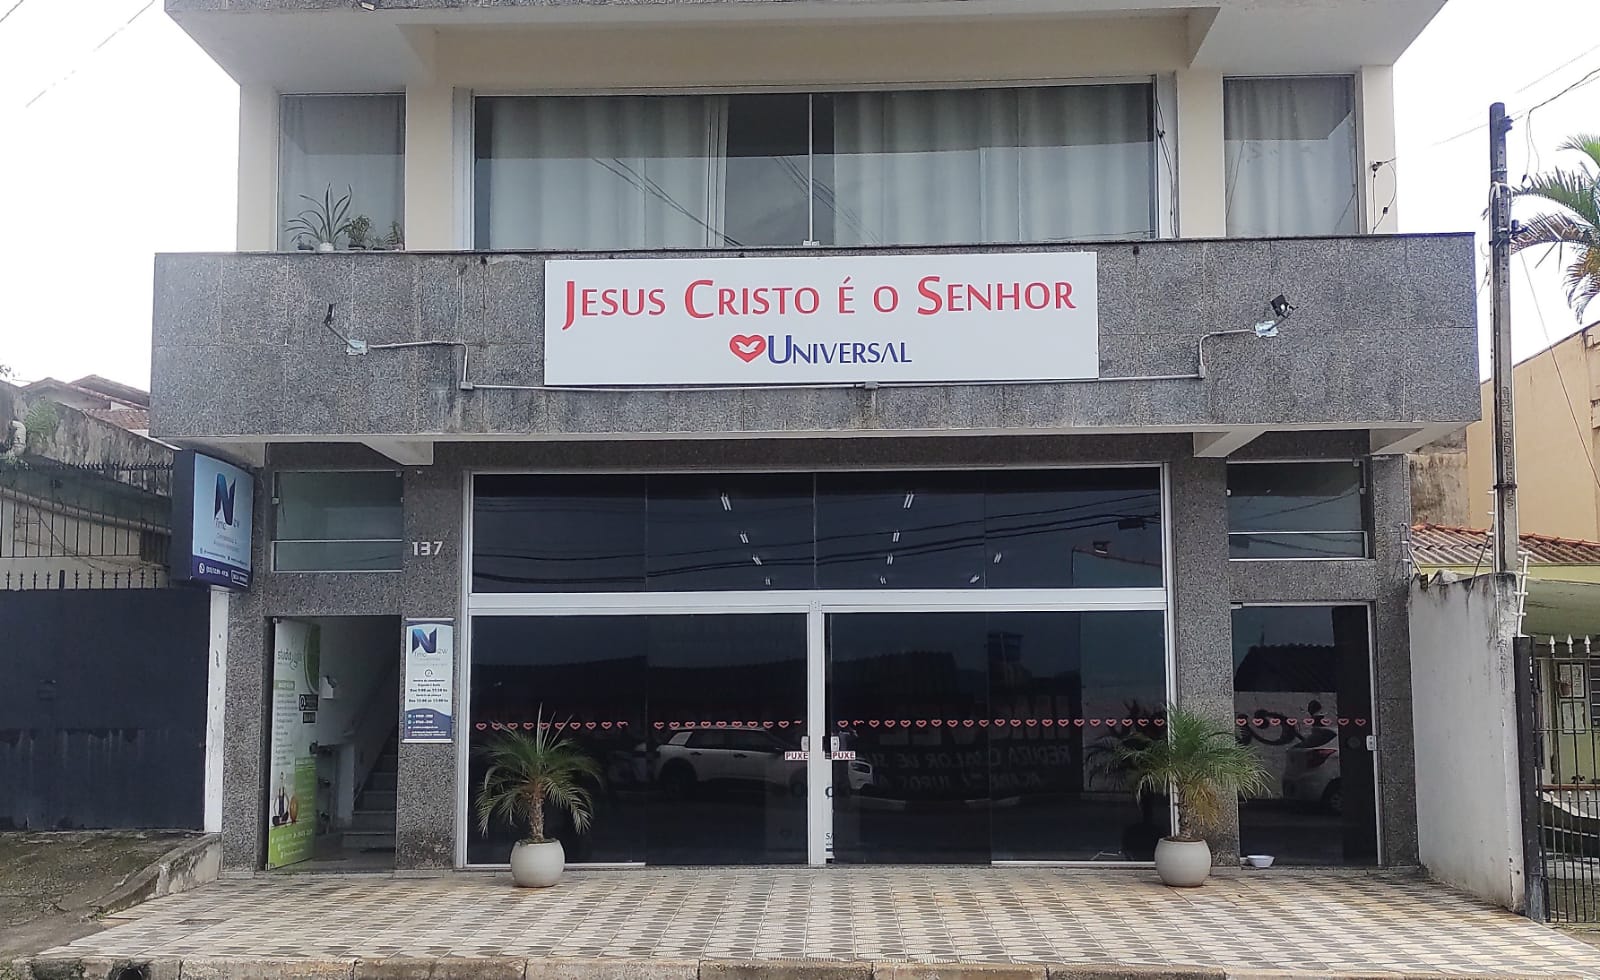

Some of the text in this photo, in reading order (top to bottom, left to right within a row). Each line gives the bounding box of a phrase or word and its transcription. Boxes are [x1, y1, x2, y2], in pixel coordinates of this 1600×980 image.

[562, 275, 1077, 330] JESUS CRISTO É O SENHOR
[767, 334, 912, 364] UNIVERSAL
[412, 541, 443, 556] 137
[785, 752, 808, 760] PUXE
[832, 752, 855, 760] PUXE
